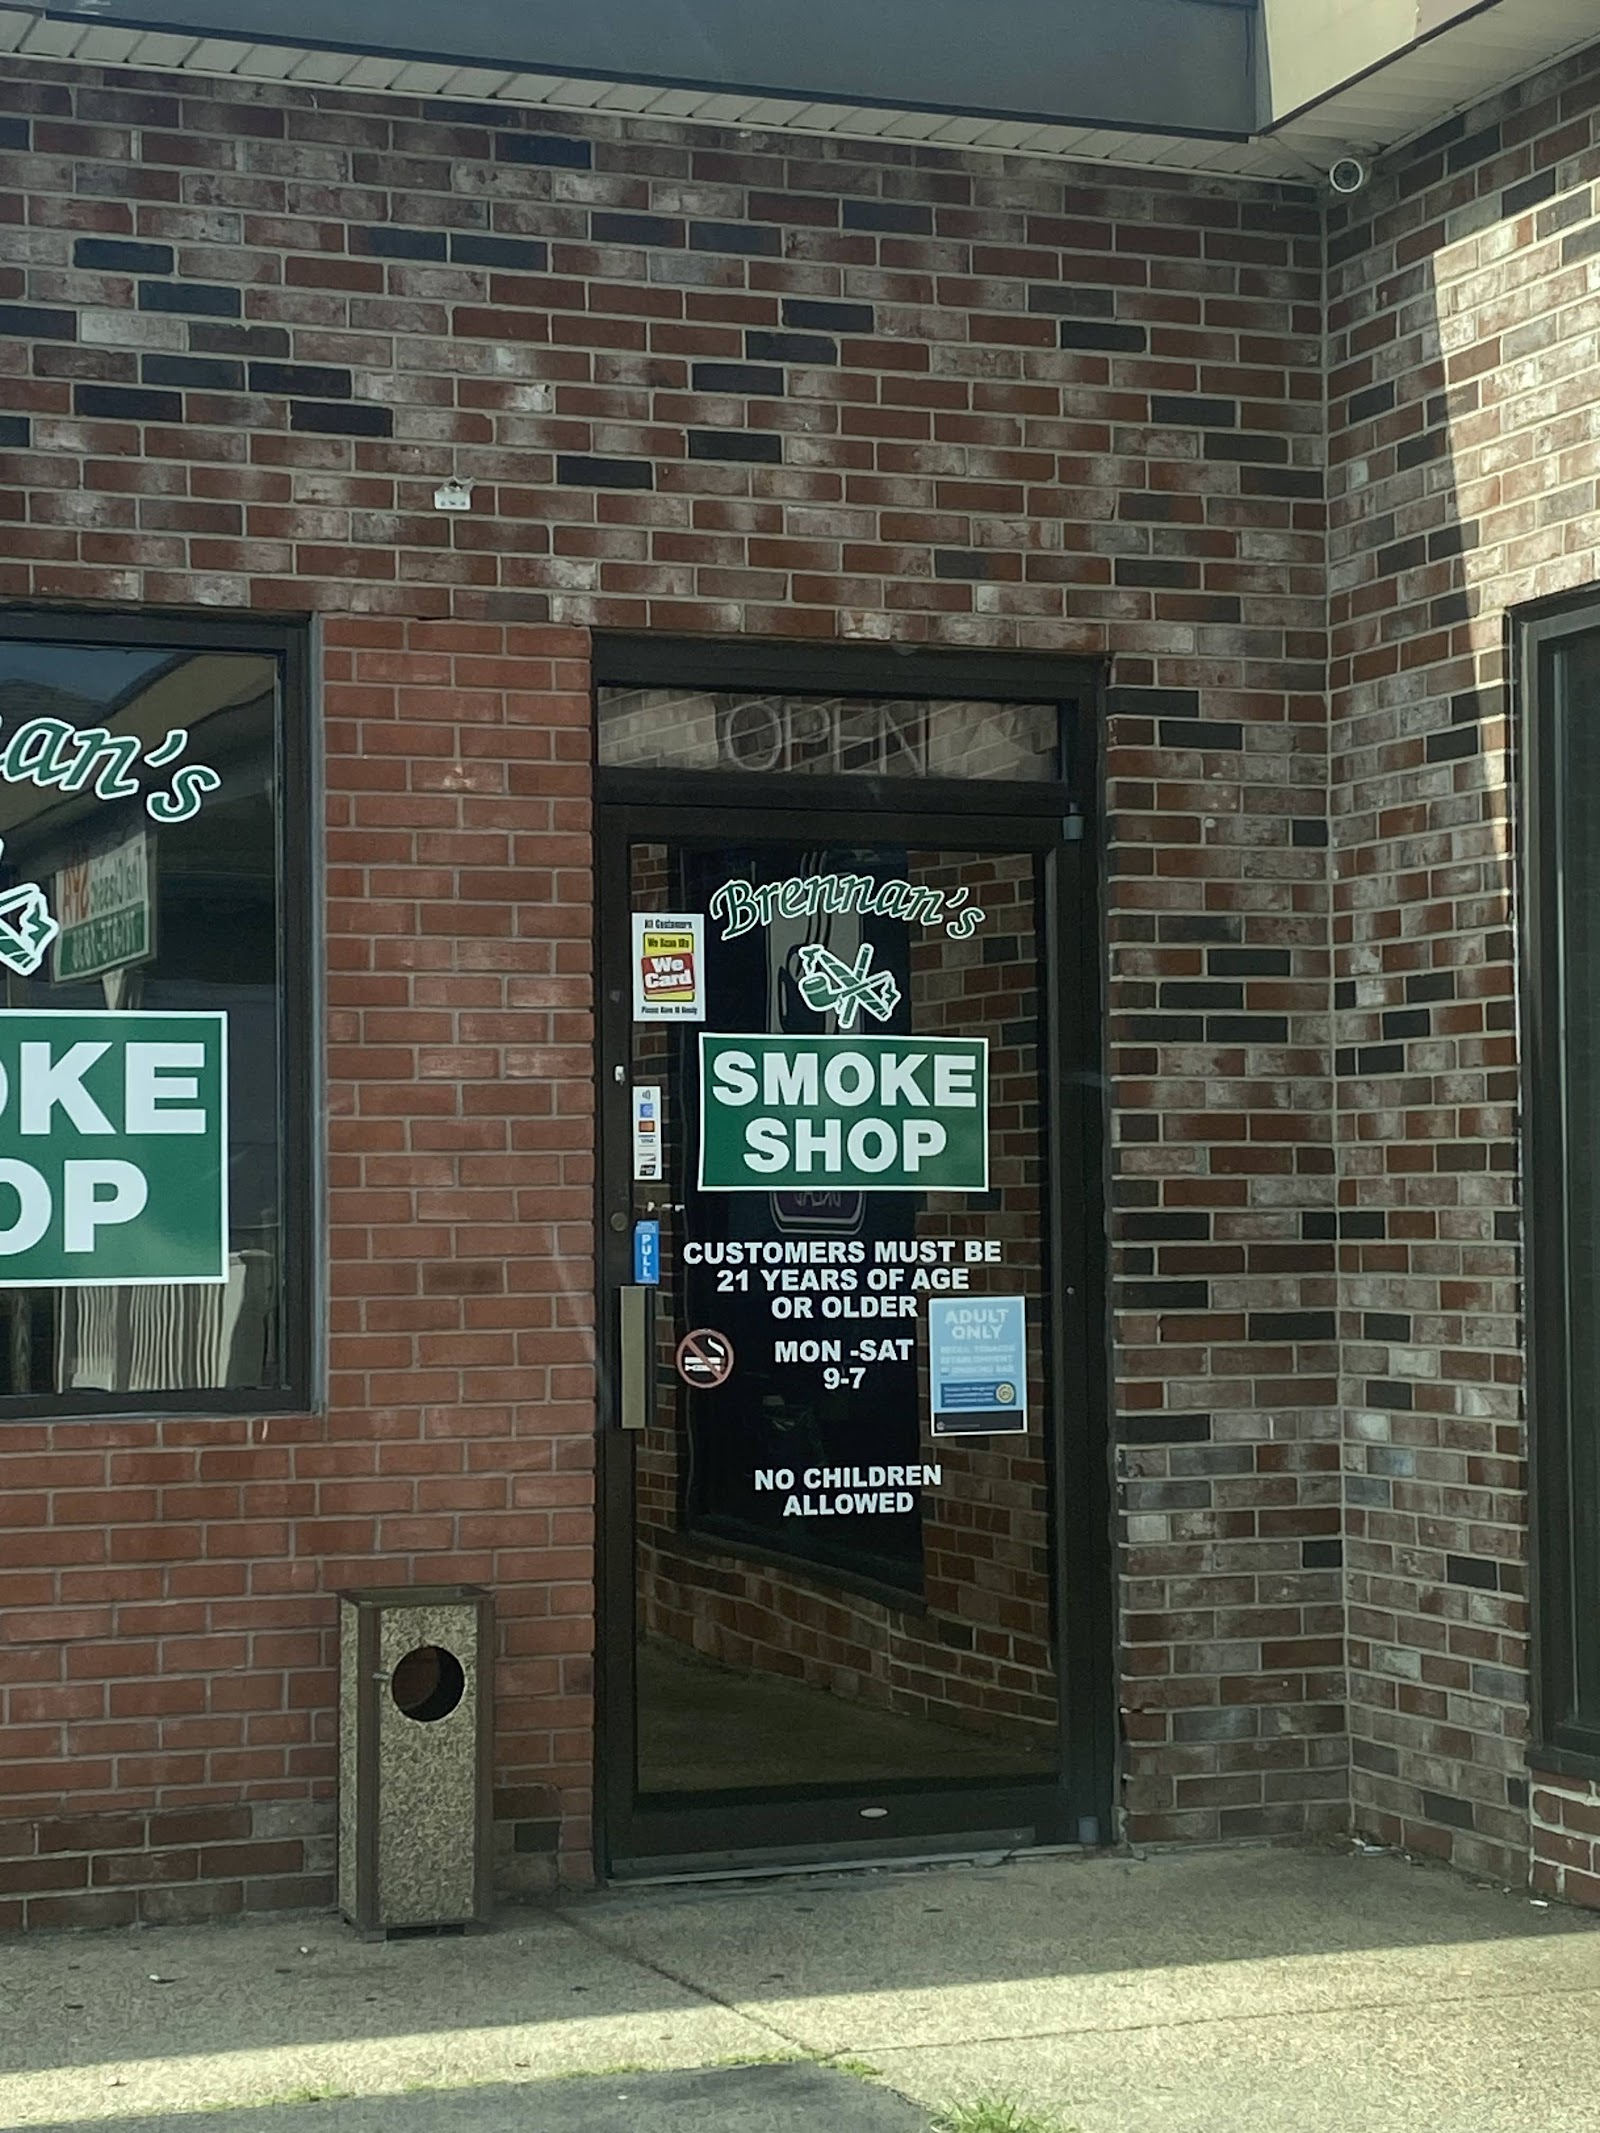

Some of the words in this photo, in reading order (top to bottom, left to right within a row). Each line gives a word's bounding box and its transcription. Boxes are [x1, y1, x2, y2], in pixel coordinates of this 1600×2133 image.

[725, 703, 926, 776] OPEN
[709, 874, 985, 941] Brennan's
[650, 956, 684, 973] We
[644, 968, 692, 989] Card
[712, 1051, 977, 1107] SMOKE
[743, 1118, 948, 1173] SHOP
[641, 1234, 652, 1277] PULL
[683, 1242, 866, 1265] CUSTOMERS
[874, 1241, 955, 1263] MUST
[964, 1241, 1002, 1263] BE
[717, 1269, 749, 1292] 21
[760, 1269, 858, 1292] YEARS
[867, 1269, 904, 1291] OF
[911, 1268, 969, 1290] AGE
[771, 1296, 814, 1319] OR
[821, 1296, 918, 1318] OLDER
[944, 1308, 1010, 1325] ADULT
[951, 1324, 1003, 1341] ONLY
[774, 1340, 842, 1363] MON
[823, 1367, 867, 1390] 9-7
[755, 1469, 796, 1491] NO
[803, 1465, 942, 1489] CHILDREN
[783, 1492, 914, 1516] ALLOWED
